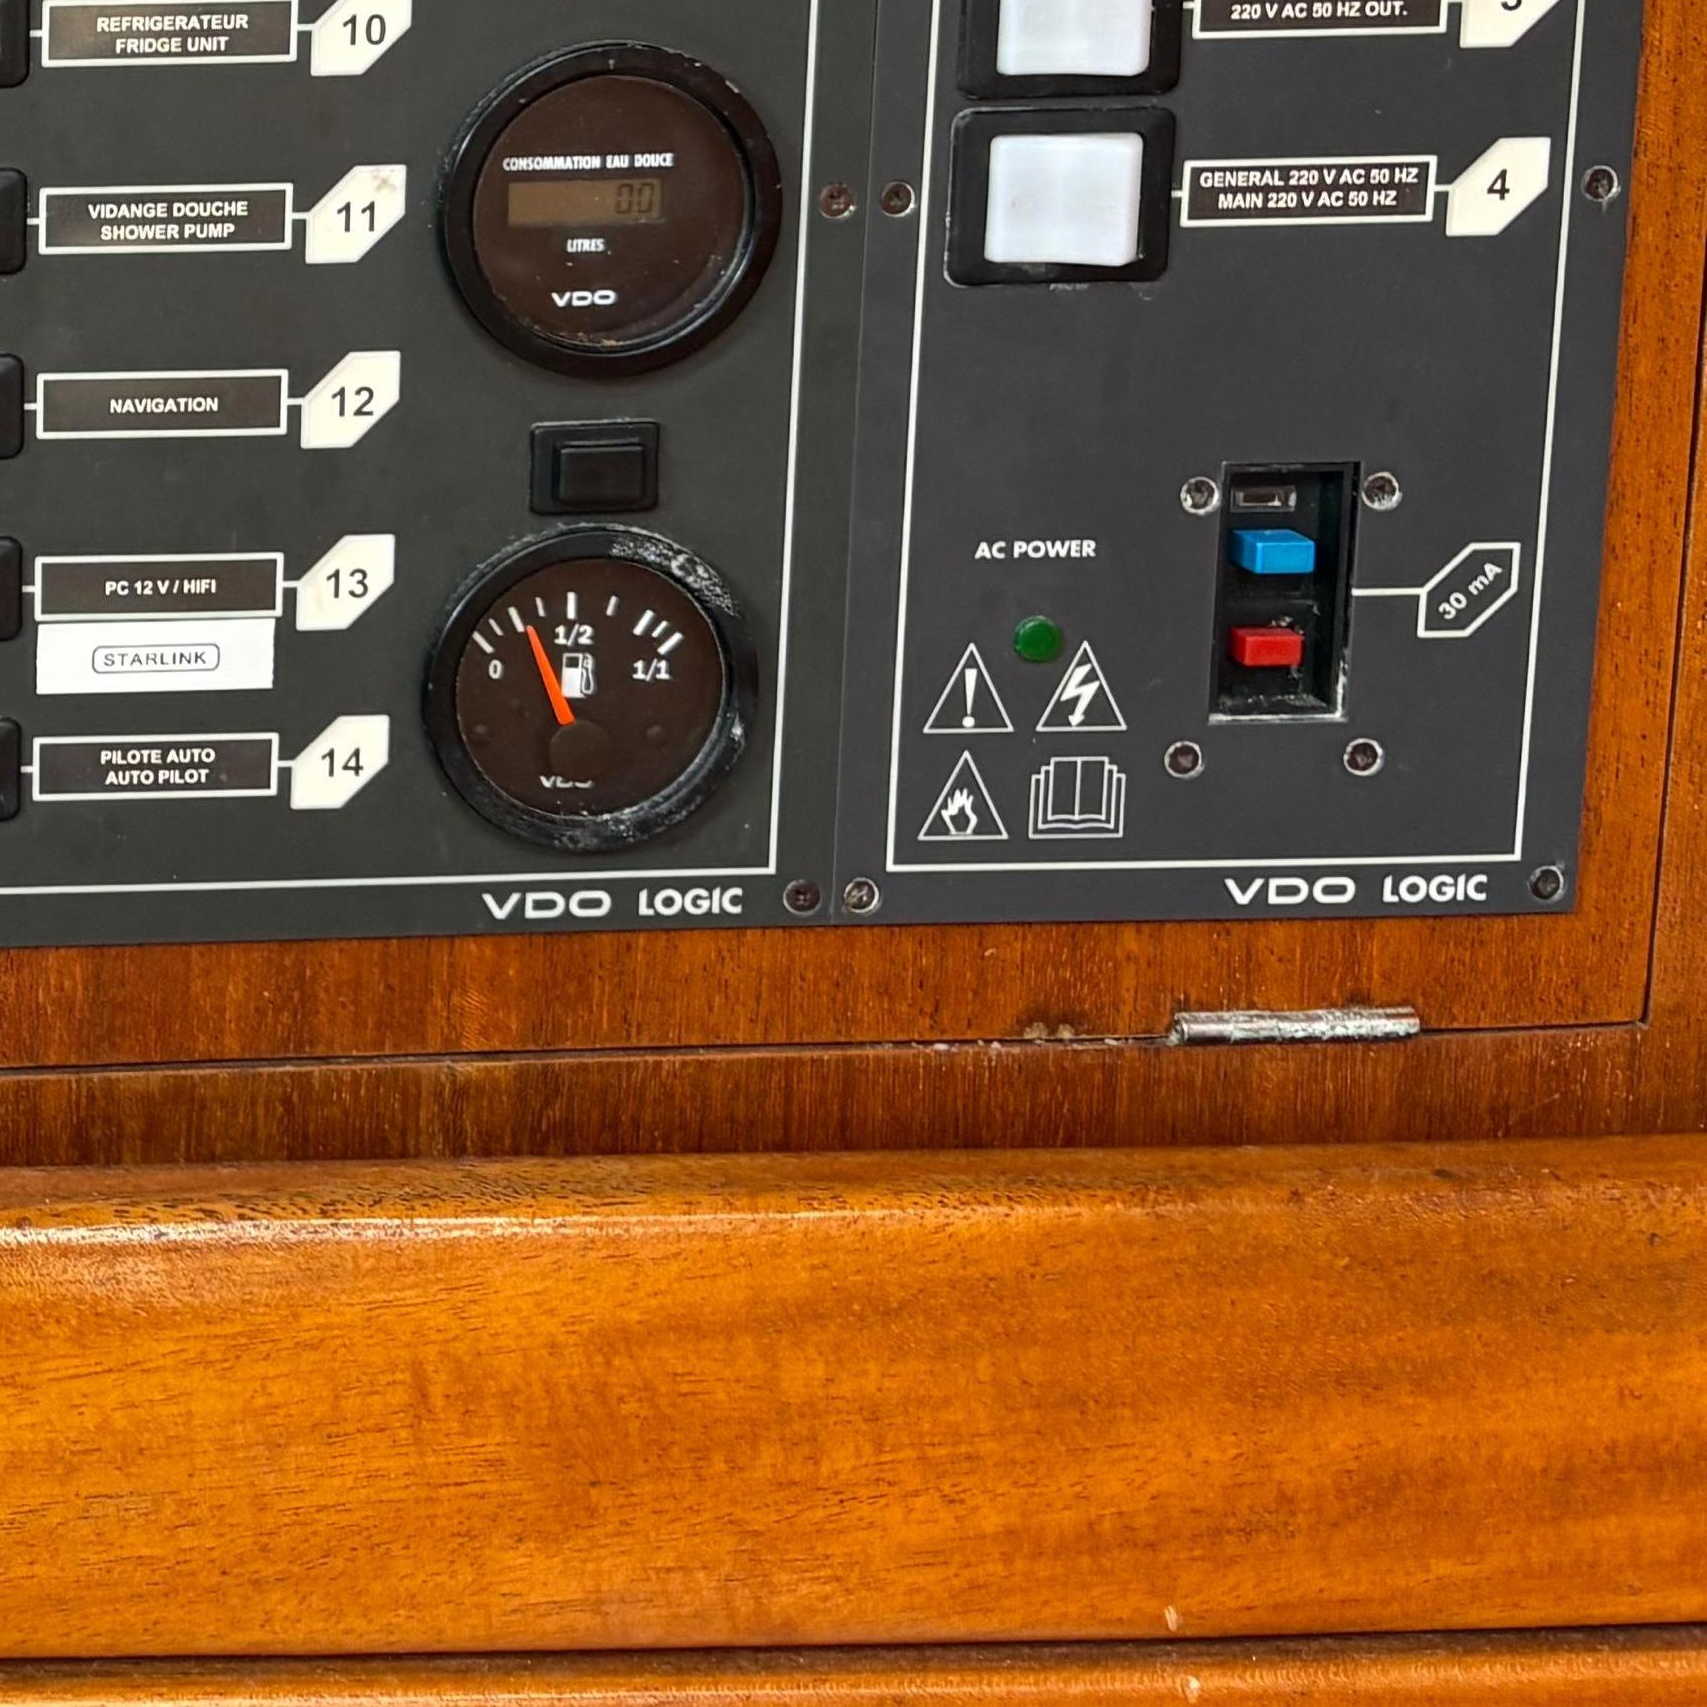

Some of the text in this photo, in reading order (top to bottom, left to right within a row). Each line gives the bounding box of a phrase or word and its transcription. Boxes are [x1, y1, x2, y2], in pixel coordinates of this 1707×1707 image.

[95, 13, 248, 33] REFRIGERATEUR
[342, 14, 386, 46] 10
[115, 34, 229, 56] FRIDGE UNIT
[503, 153, 674, 171] CONSOMMATION EAU DOUCE
[1487, 169, 1510, 199] 4
[88, 200, 248, 219] VIDANGE DOUCHE
[336, 202, 380, 233] 11
[567, 239, 604, 252] LITRES
[550, 289, 617, 307] VDO
[108, 396, 219, 414] NAVIGATION
[331, 386, 374, 418] 12
[974, 540, 1097, 560] AC POWER
[326, 569, 369, 598] 13
[1437, 562, 1504, 621] 30 mA
[554, 625, 594, 646] 1/2
[103, 651, 207, 667] STARLINK
[632, 659, 671, 680] 1/1
[100, 746, 215, 766] PILOTE AUTO
[322, 748, 364, 778] 14
[1223, 875, 1488, 905] VDO LOGIC
[482, 888, 743, 920] VDO LOGIC
